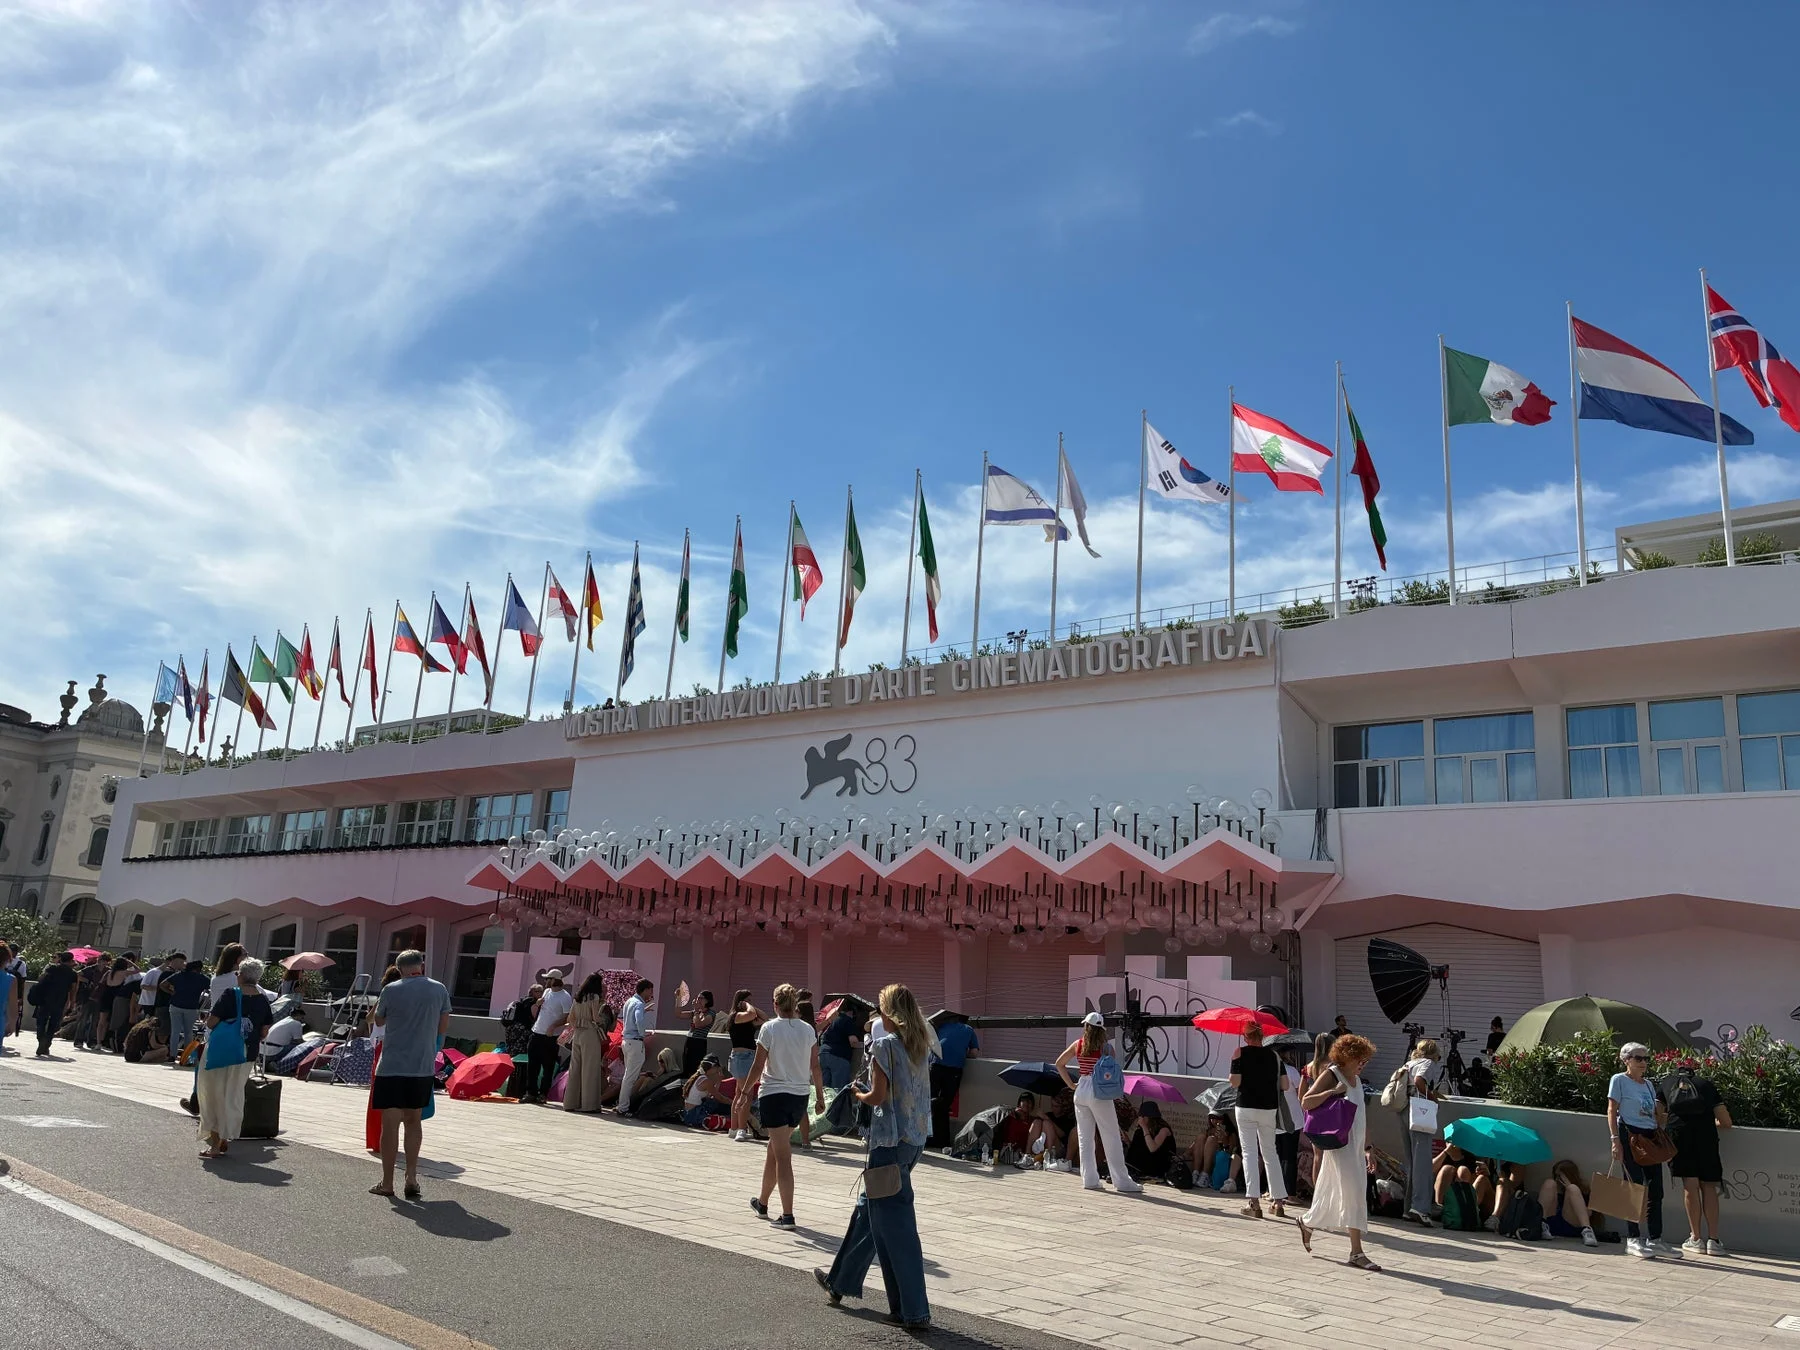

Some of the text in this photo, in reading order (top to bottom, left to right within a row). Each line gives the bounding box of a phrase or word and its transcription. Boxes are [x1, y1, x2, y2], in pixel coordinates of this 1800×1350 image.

[563, 621, 1264, 740] MOSTRA INTERNAZIONALE D'ARTE CINEMATOGRAFICA
[861, 734, 917, 795] 83
[1731, 1169, 1773, 1203] 83
